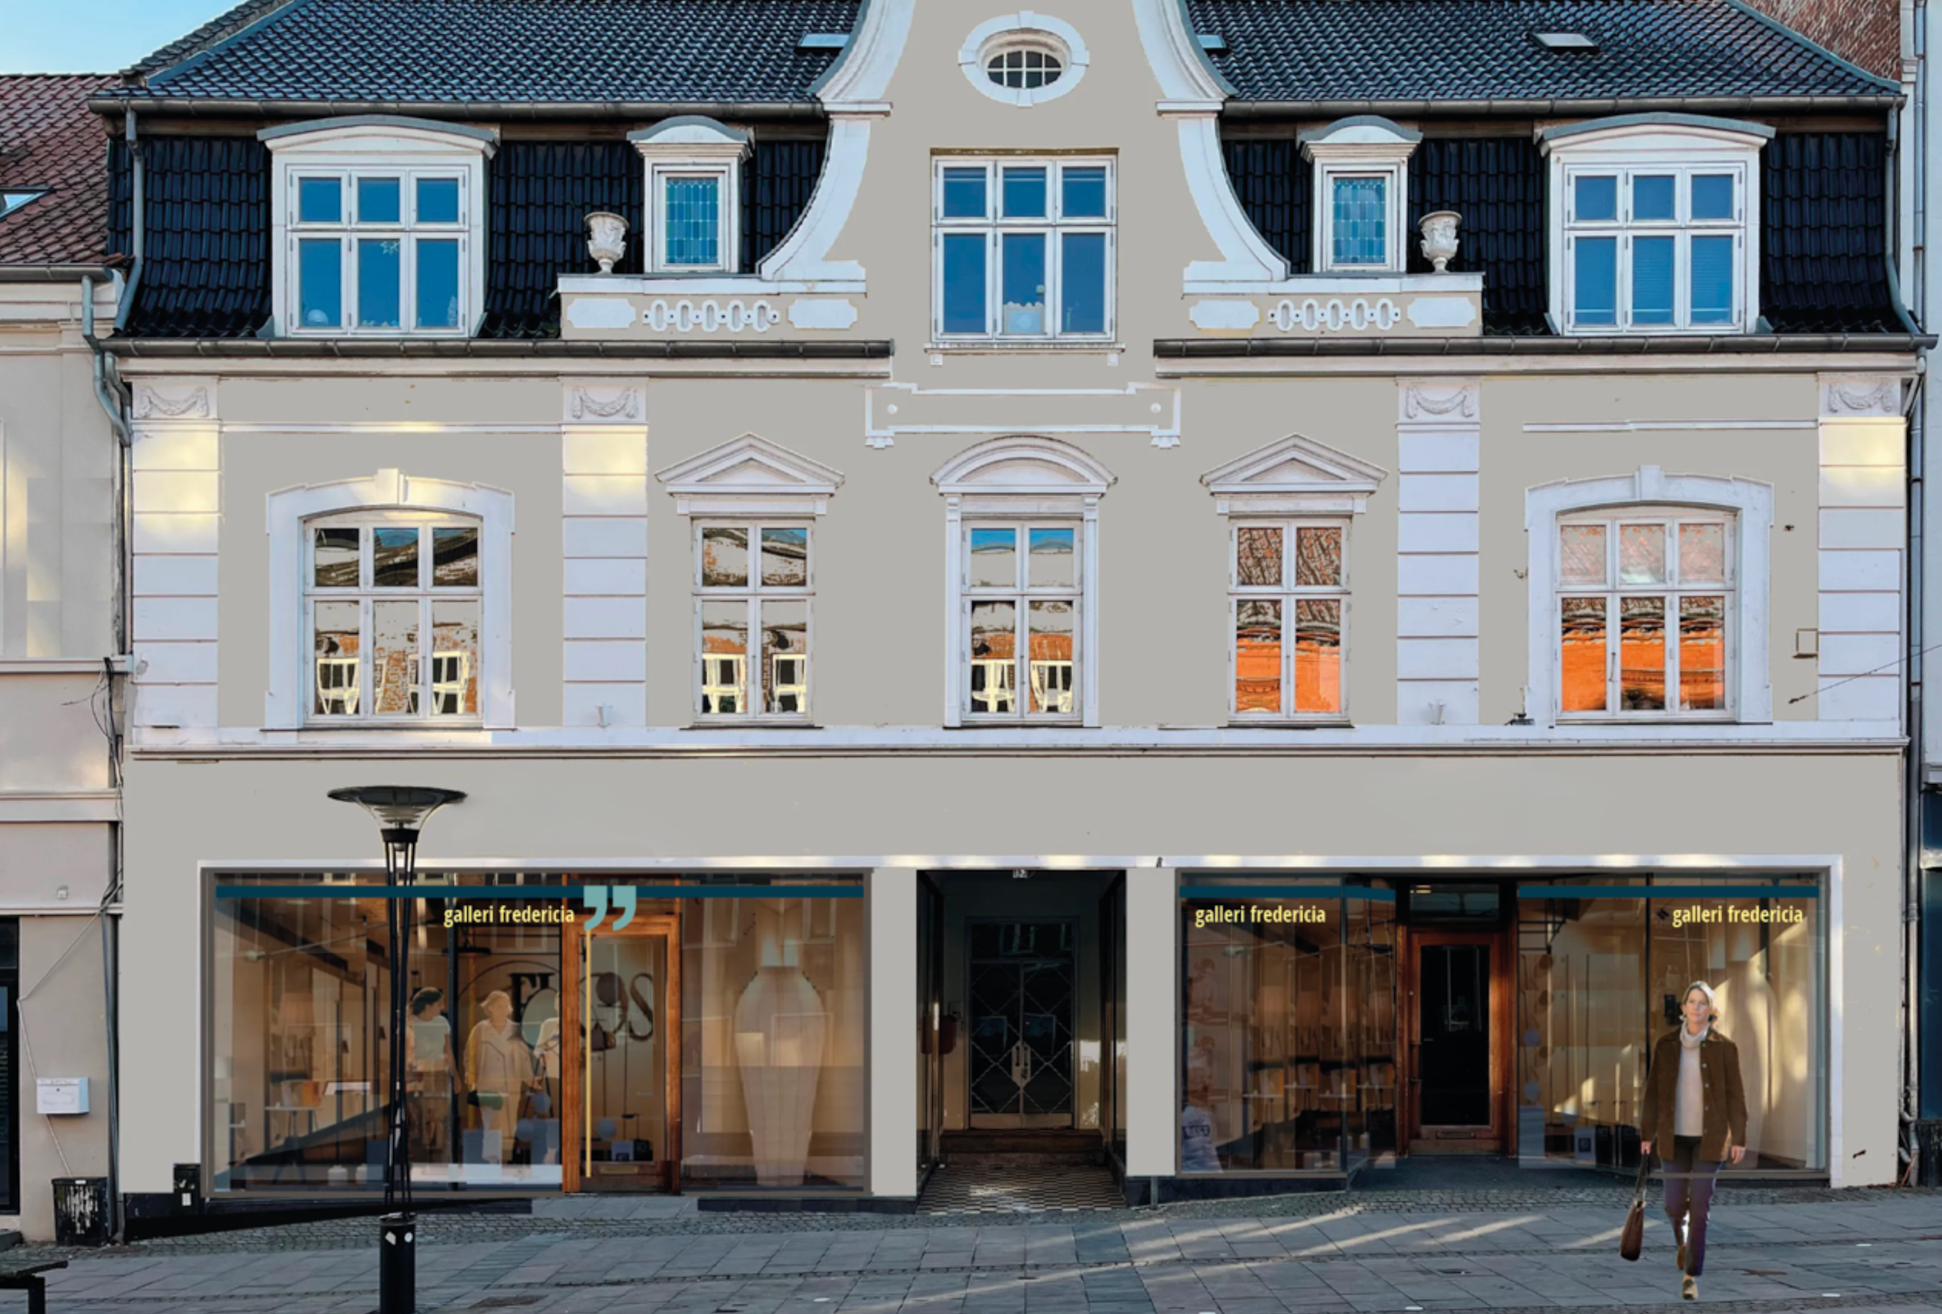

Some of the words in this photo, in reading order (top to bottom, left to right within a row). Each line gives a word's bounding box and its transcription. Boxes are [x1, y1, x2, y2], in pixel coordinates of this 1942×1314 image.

[443, 905, 494, 928] galleri
[499, 905, 574, 922] fredericia
[1195, 905, 1245, 928] galleri
[1250, 905, 1326, 922] fredericia
[1672, 905, 1723, 928] galleri
[1728, 905, 1804, 922] fredericia
